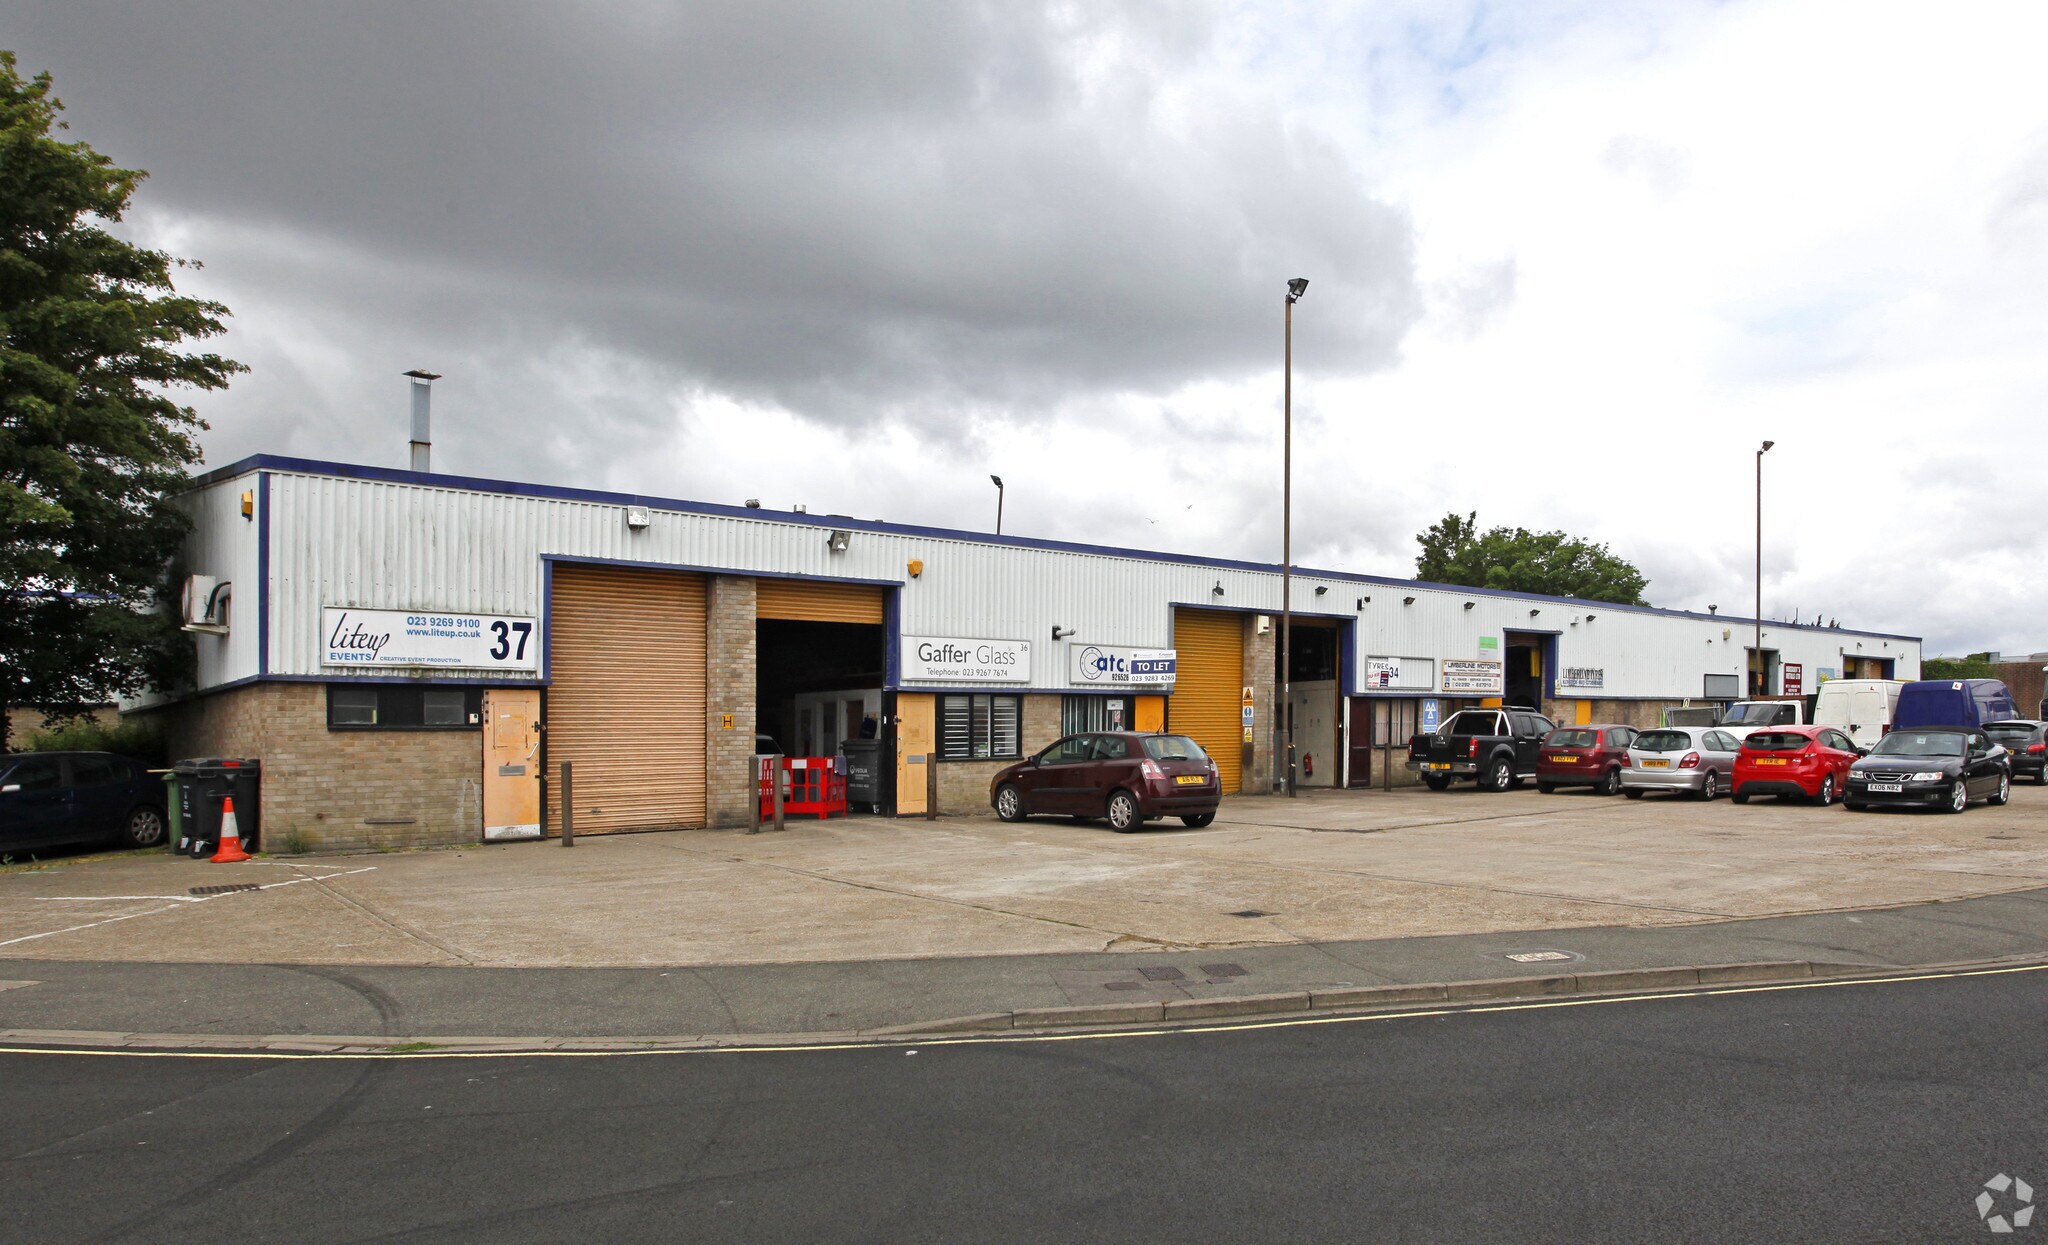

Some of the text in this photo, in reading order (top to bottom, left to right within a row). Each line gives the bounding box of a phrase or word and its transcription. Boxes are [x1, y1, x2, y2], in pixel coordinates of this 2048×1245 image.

[407, 616, 480, 628] 023 9269 9100
[406, 628, 481, 639] www.liteup.co.uk
[489, 620, 532, 661] 37
[1020, 643, 1028, 651] 36
[330, 652, 372, 661] EVENTS
[918, 643, 1016, 665] Gaffer Glass
[1137, 662, 1170, 671] TO LET
[1368, 662, 1389, 670] TYRES
[926, 667, 961, 677] Telephone:
[962, 668, 974, 676] 023
[1390, 666, 1399, 678] 34
